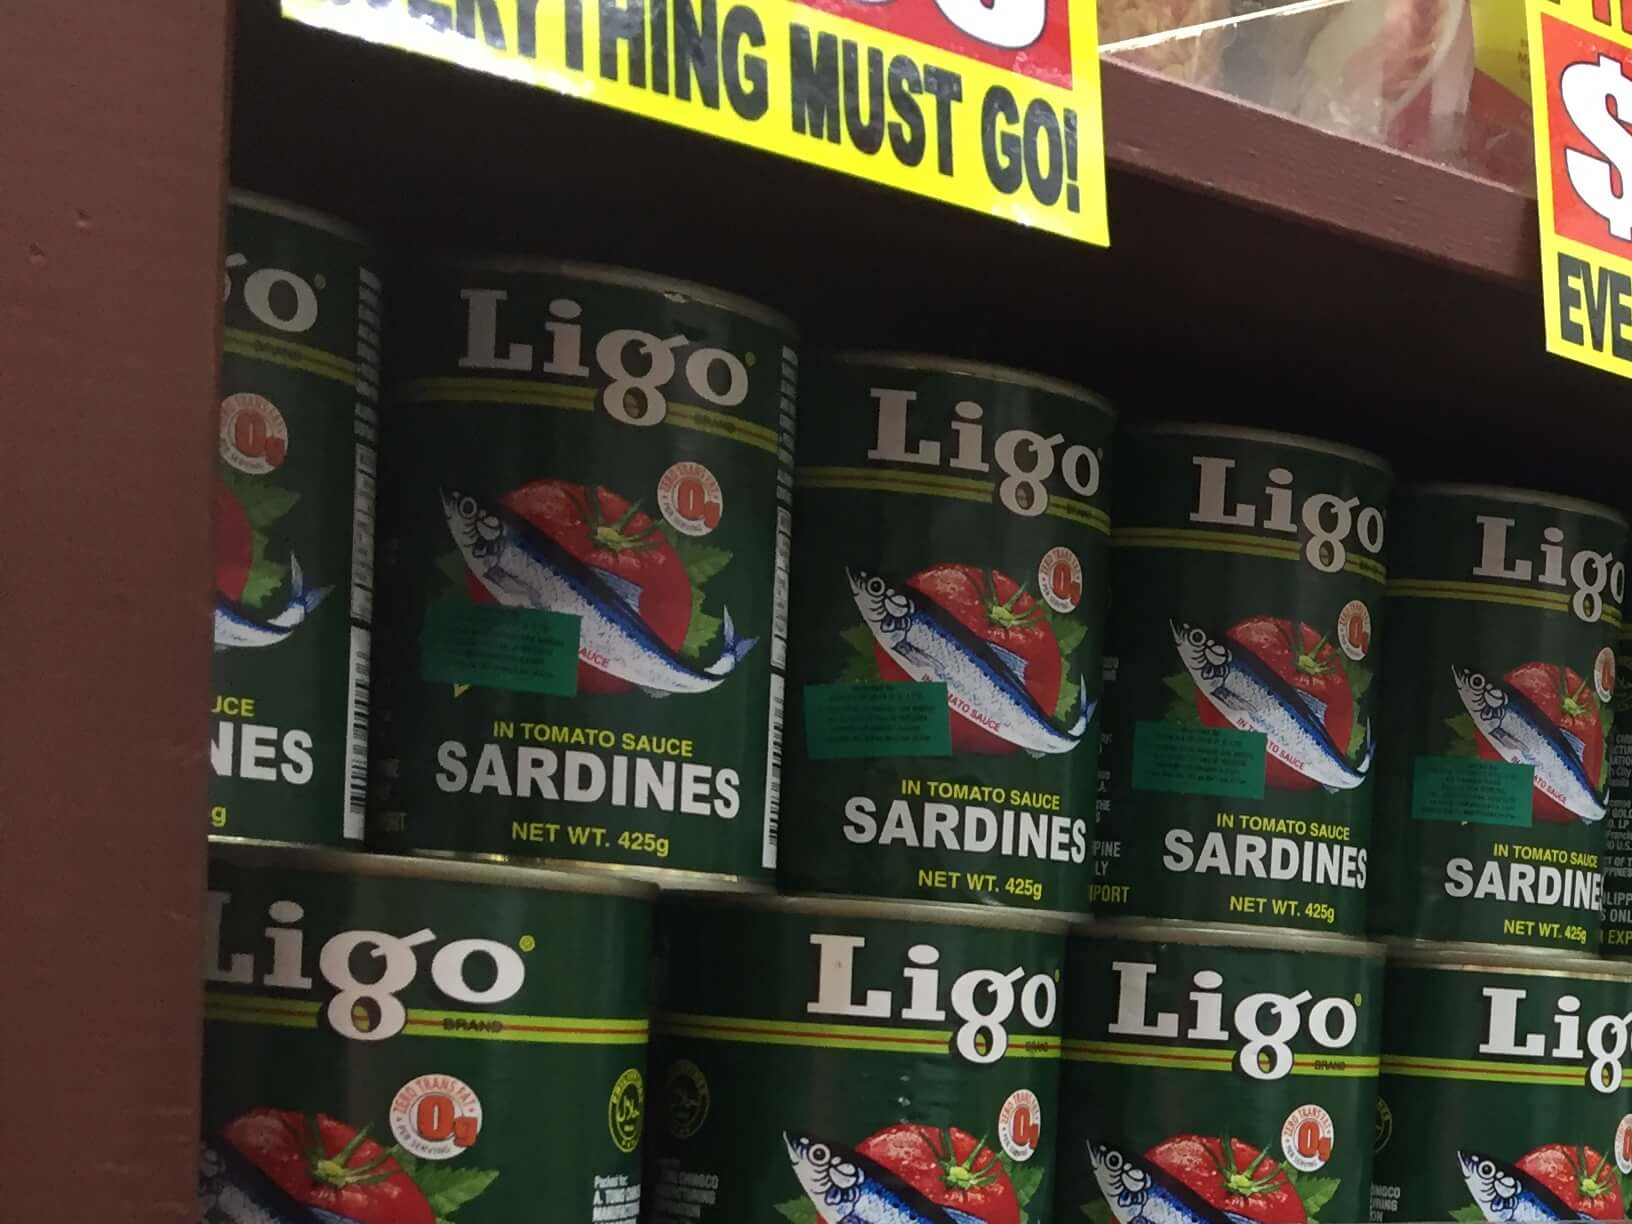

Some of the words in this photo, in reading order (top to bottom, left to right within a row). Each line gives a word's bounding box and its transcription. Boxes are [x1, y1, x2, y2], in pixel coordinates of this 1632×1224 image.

[792, 23, 963, 177] MUST
[982, 83, 1081, 214] GO!
[457, 287, 751, 428] Ligo
[867, 387, 1101, 518] Ligo
[1189, 455, 1386, 575] Ligo
[1472, 515, 1626, 624] Ligo
[493, 720, 514, 740] IN
[519, 722, 617, 750] TOMATO
[622, 732, 694, 758] SAUCE
[436, 739, 741, 820] SARDINES
[901, 779, 921, 797] IN
[926, 780, 1006, 804] TOMATO
[1010, 787, 1061, 812] SAUCE
[511, 821, 560, 844] NET
[566, 825, 611, 849] WT.
[617, 831, 670, 858] 425g
[843, 796, 1088, 866] SARDINES
[1162, 829, 1369, 891] SARDINES
[1217, 813, 1234, 830] IN
[1238, 815, 1307, 837] TOMATO
[1309, 821, 1352, 843] SAUCE
[1493, 843, 1510, 858] IN
[1512, 844, 1568, 865] TOMATO
[1570, 851, 1599, 870] SAUCE
[918, 869, 960, 890] NET
[965, 873, 1001, 895] WT.
[1004, 876, 1044, 902] 425g
[1229, 895, 1266, 914] NET
[1270, 898, 1302, 919] WT.
[1304, 902, 1336, 924] 425g
[1503, 919, 1536, 936] NET
[1538, 922, 1563, 941] WT.
[1564, 924, 1588, 945] 425g
[205, 890, 526, 1041] Ligo
[806, 932, 1058, 1065] Ligo
[442, 1016, 504, 1033] BRAND
[1108, 959, 1360, 1082] Ligo
